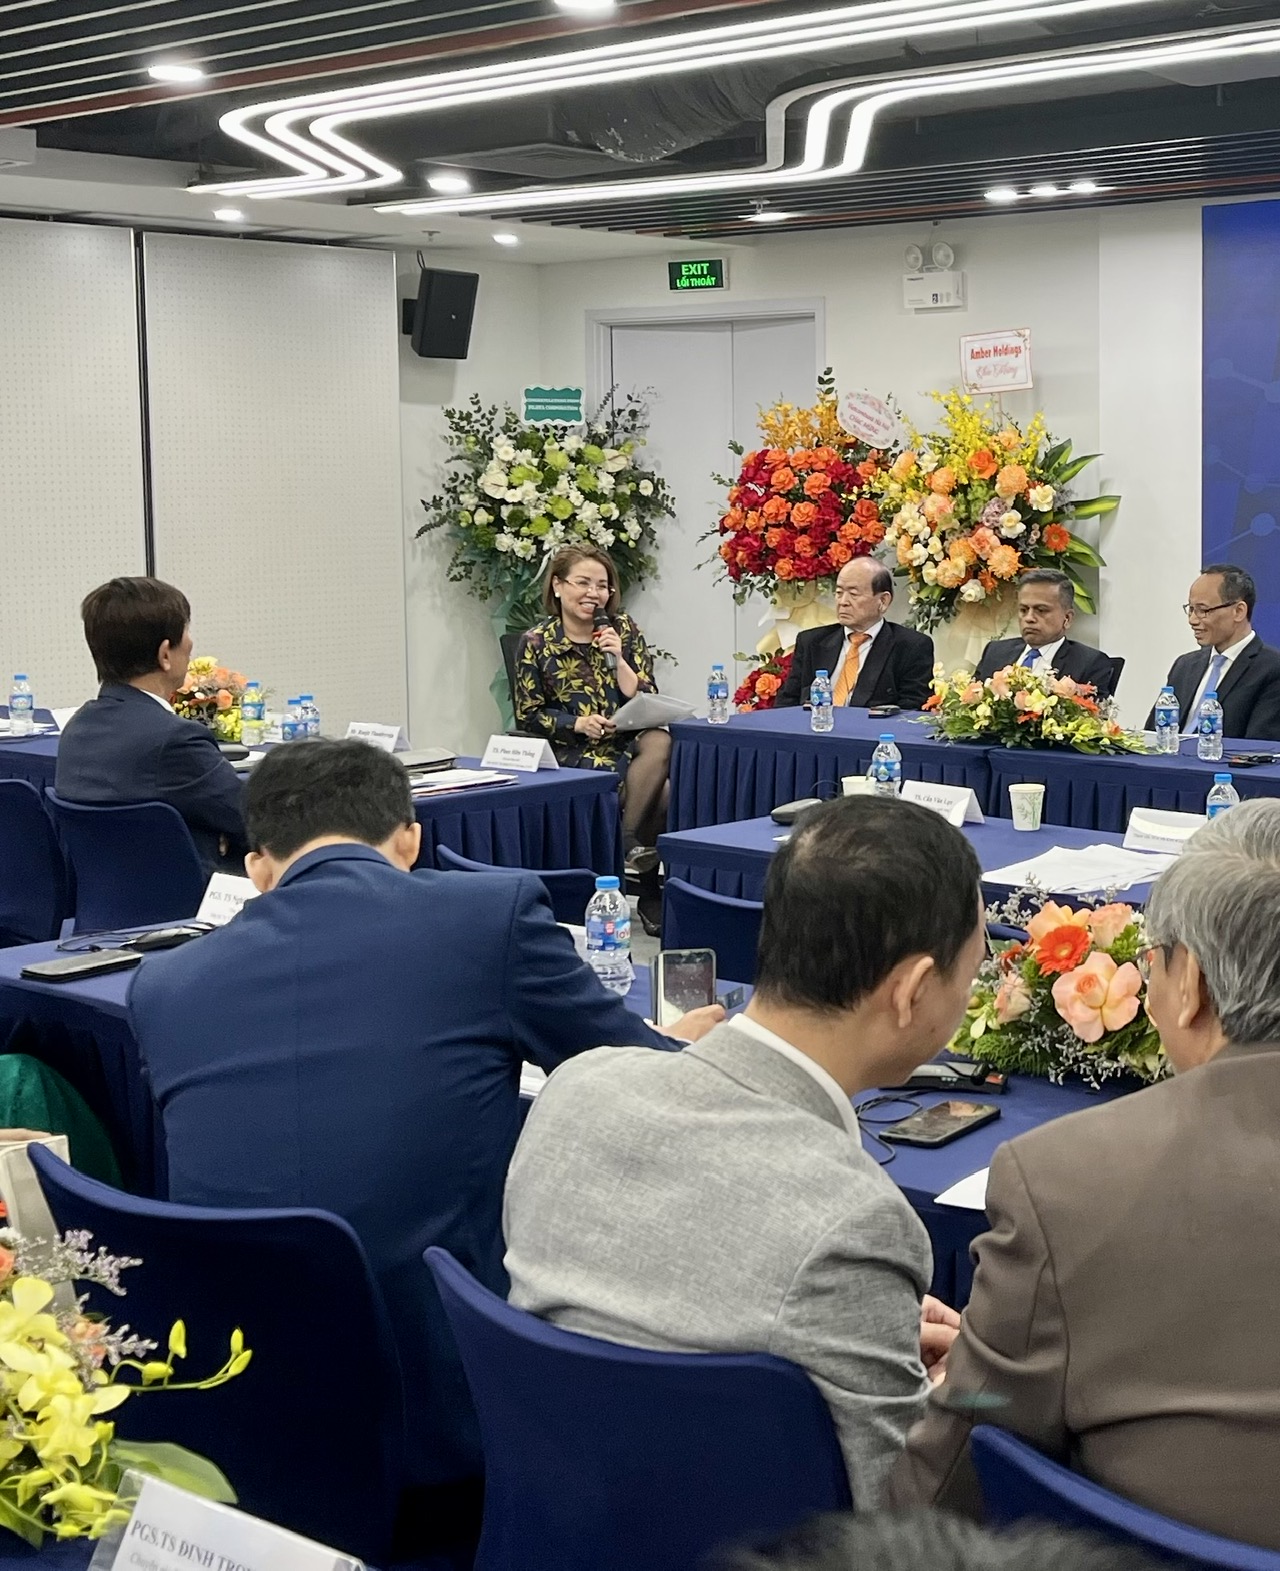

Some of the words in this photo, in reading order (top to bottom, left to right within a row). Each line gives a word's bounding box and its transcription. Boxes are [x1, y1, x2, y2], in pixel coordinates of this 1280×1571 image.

[681, 263, 709, 275] EXIT
[690, 275, 716, 287] THOÁT
[970, 347, 991, 360] Amber
[993, 344, 1022, 358] Holdings
[131, 1520, 176, 1552] PGS.TS
